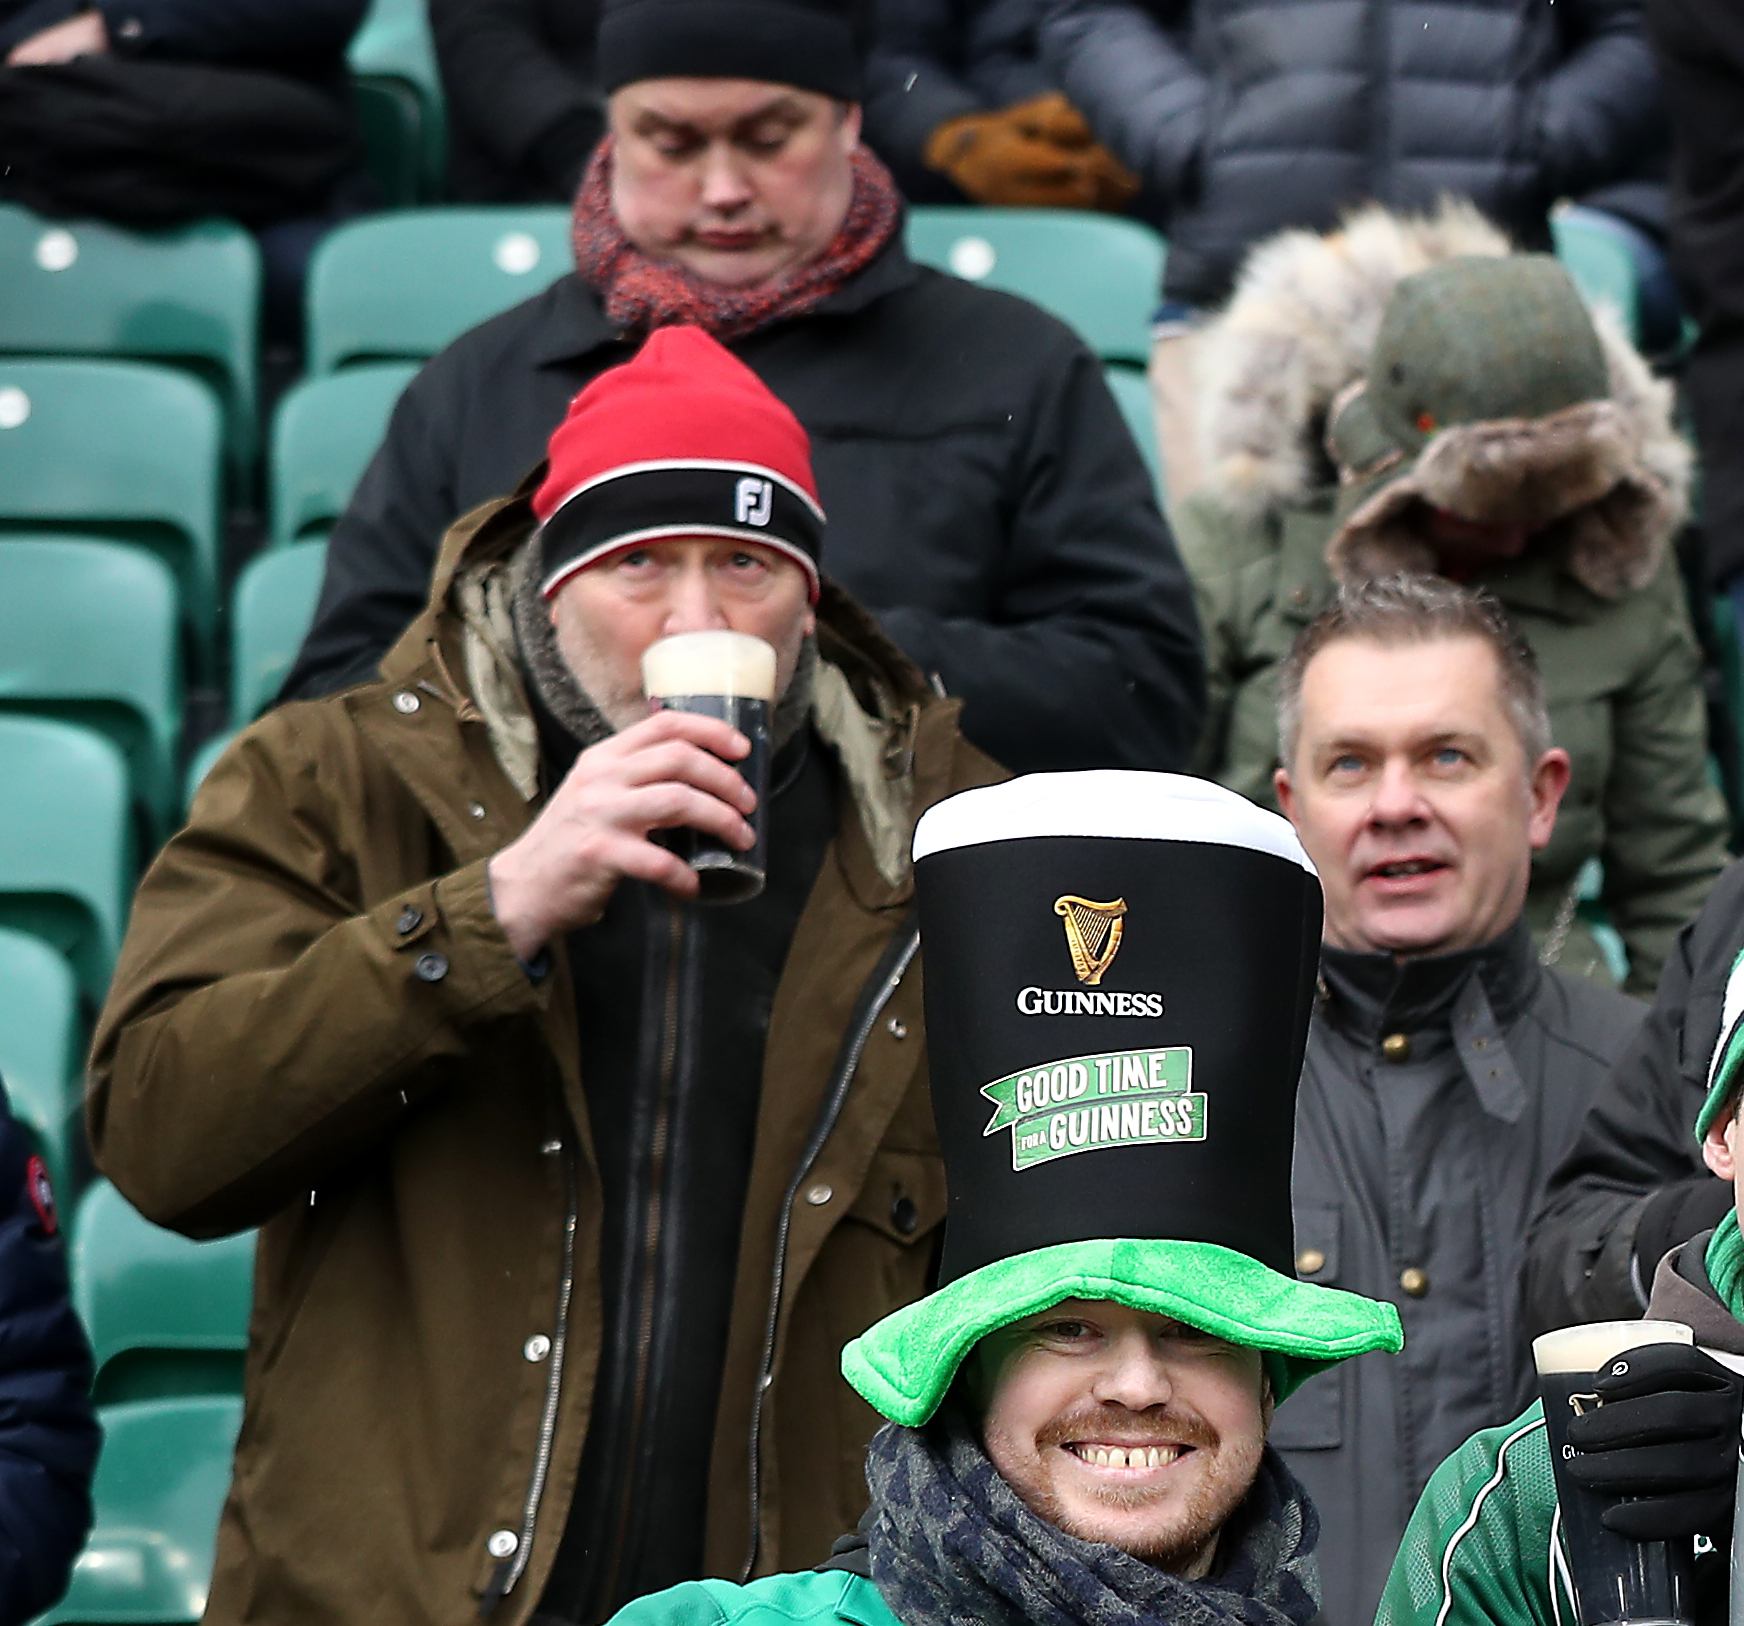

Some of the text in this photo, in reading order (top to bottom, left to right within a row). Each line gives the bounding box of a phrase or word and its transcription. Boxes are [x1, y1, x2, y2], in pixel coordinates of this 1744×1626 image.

[735, 477, 773, 527] FJ
[1017, 987, 1164, 1017] GUINNESS
[1016, 1052, 1167, 1113] GOOD TIME
[1049, 1098, 1194, 1150] GUINNESS
